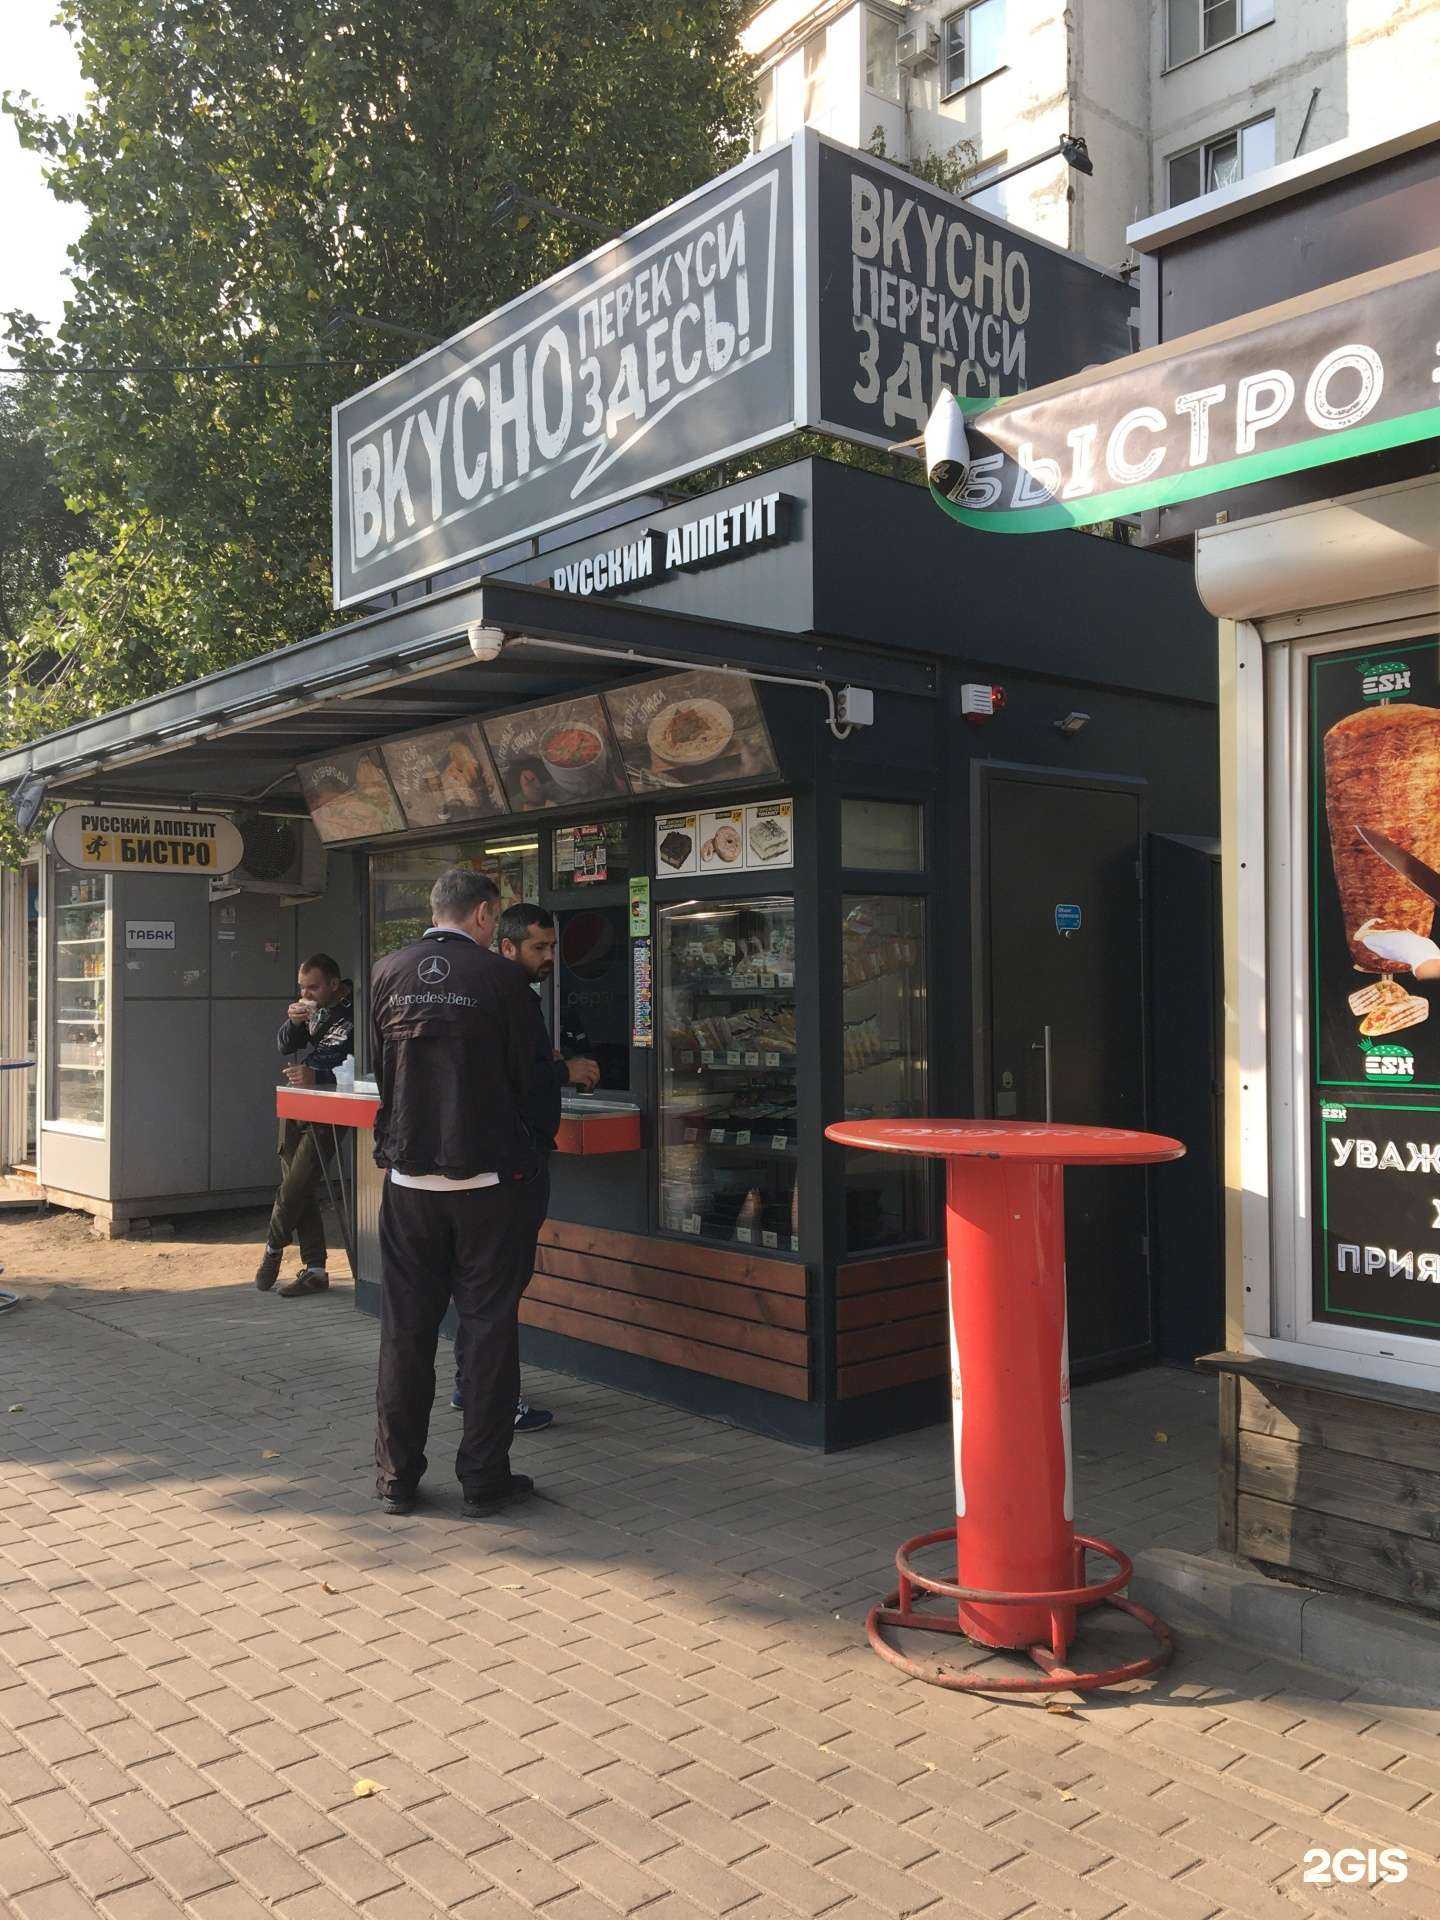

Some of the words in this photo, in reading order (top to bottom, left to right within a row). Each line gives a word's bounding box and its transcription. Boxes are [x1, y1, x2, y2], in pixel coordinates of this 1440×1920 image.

[579, 209, 746, 360] ПЕРЕКУСИ
[851, 173, 1031, 326] ВКУСНО
[578, 264, 751, 441] ЗДЕСЬ!
[852, 255, 1027, 380] ПЕРЕКУСИ
[351, 324, 574, 559] ВКУСНО
[947, 343, 1385, 509] БЫСТРО
[553, 528, 653, 596] РУССКИЙ
[665, 491, 781, 570] АППЕТИТ
[81, 815, 150, 834] РУССКИЙ
[153, 819, 217, 838] АППЕТИТ
[120, 838, 211, 867] БИСТРО
[127, 929, 174, 941] ТАБАК
[388, 991, 479, 1008] Mercedes-Benz
